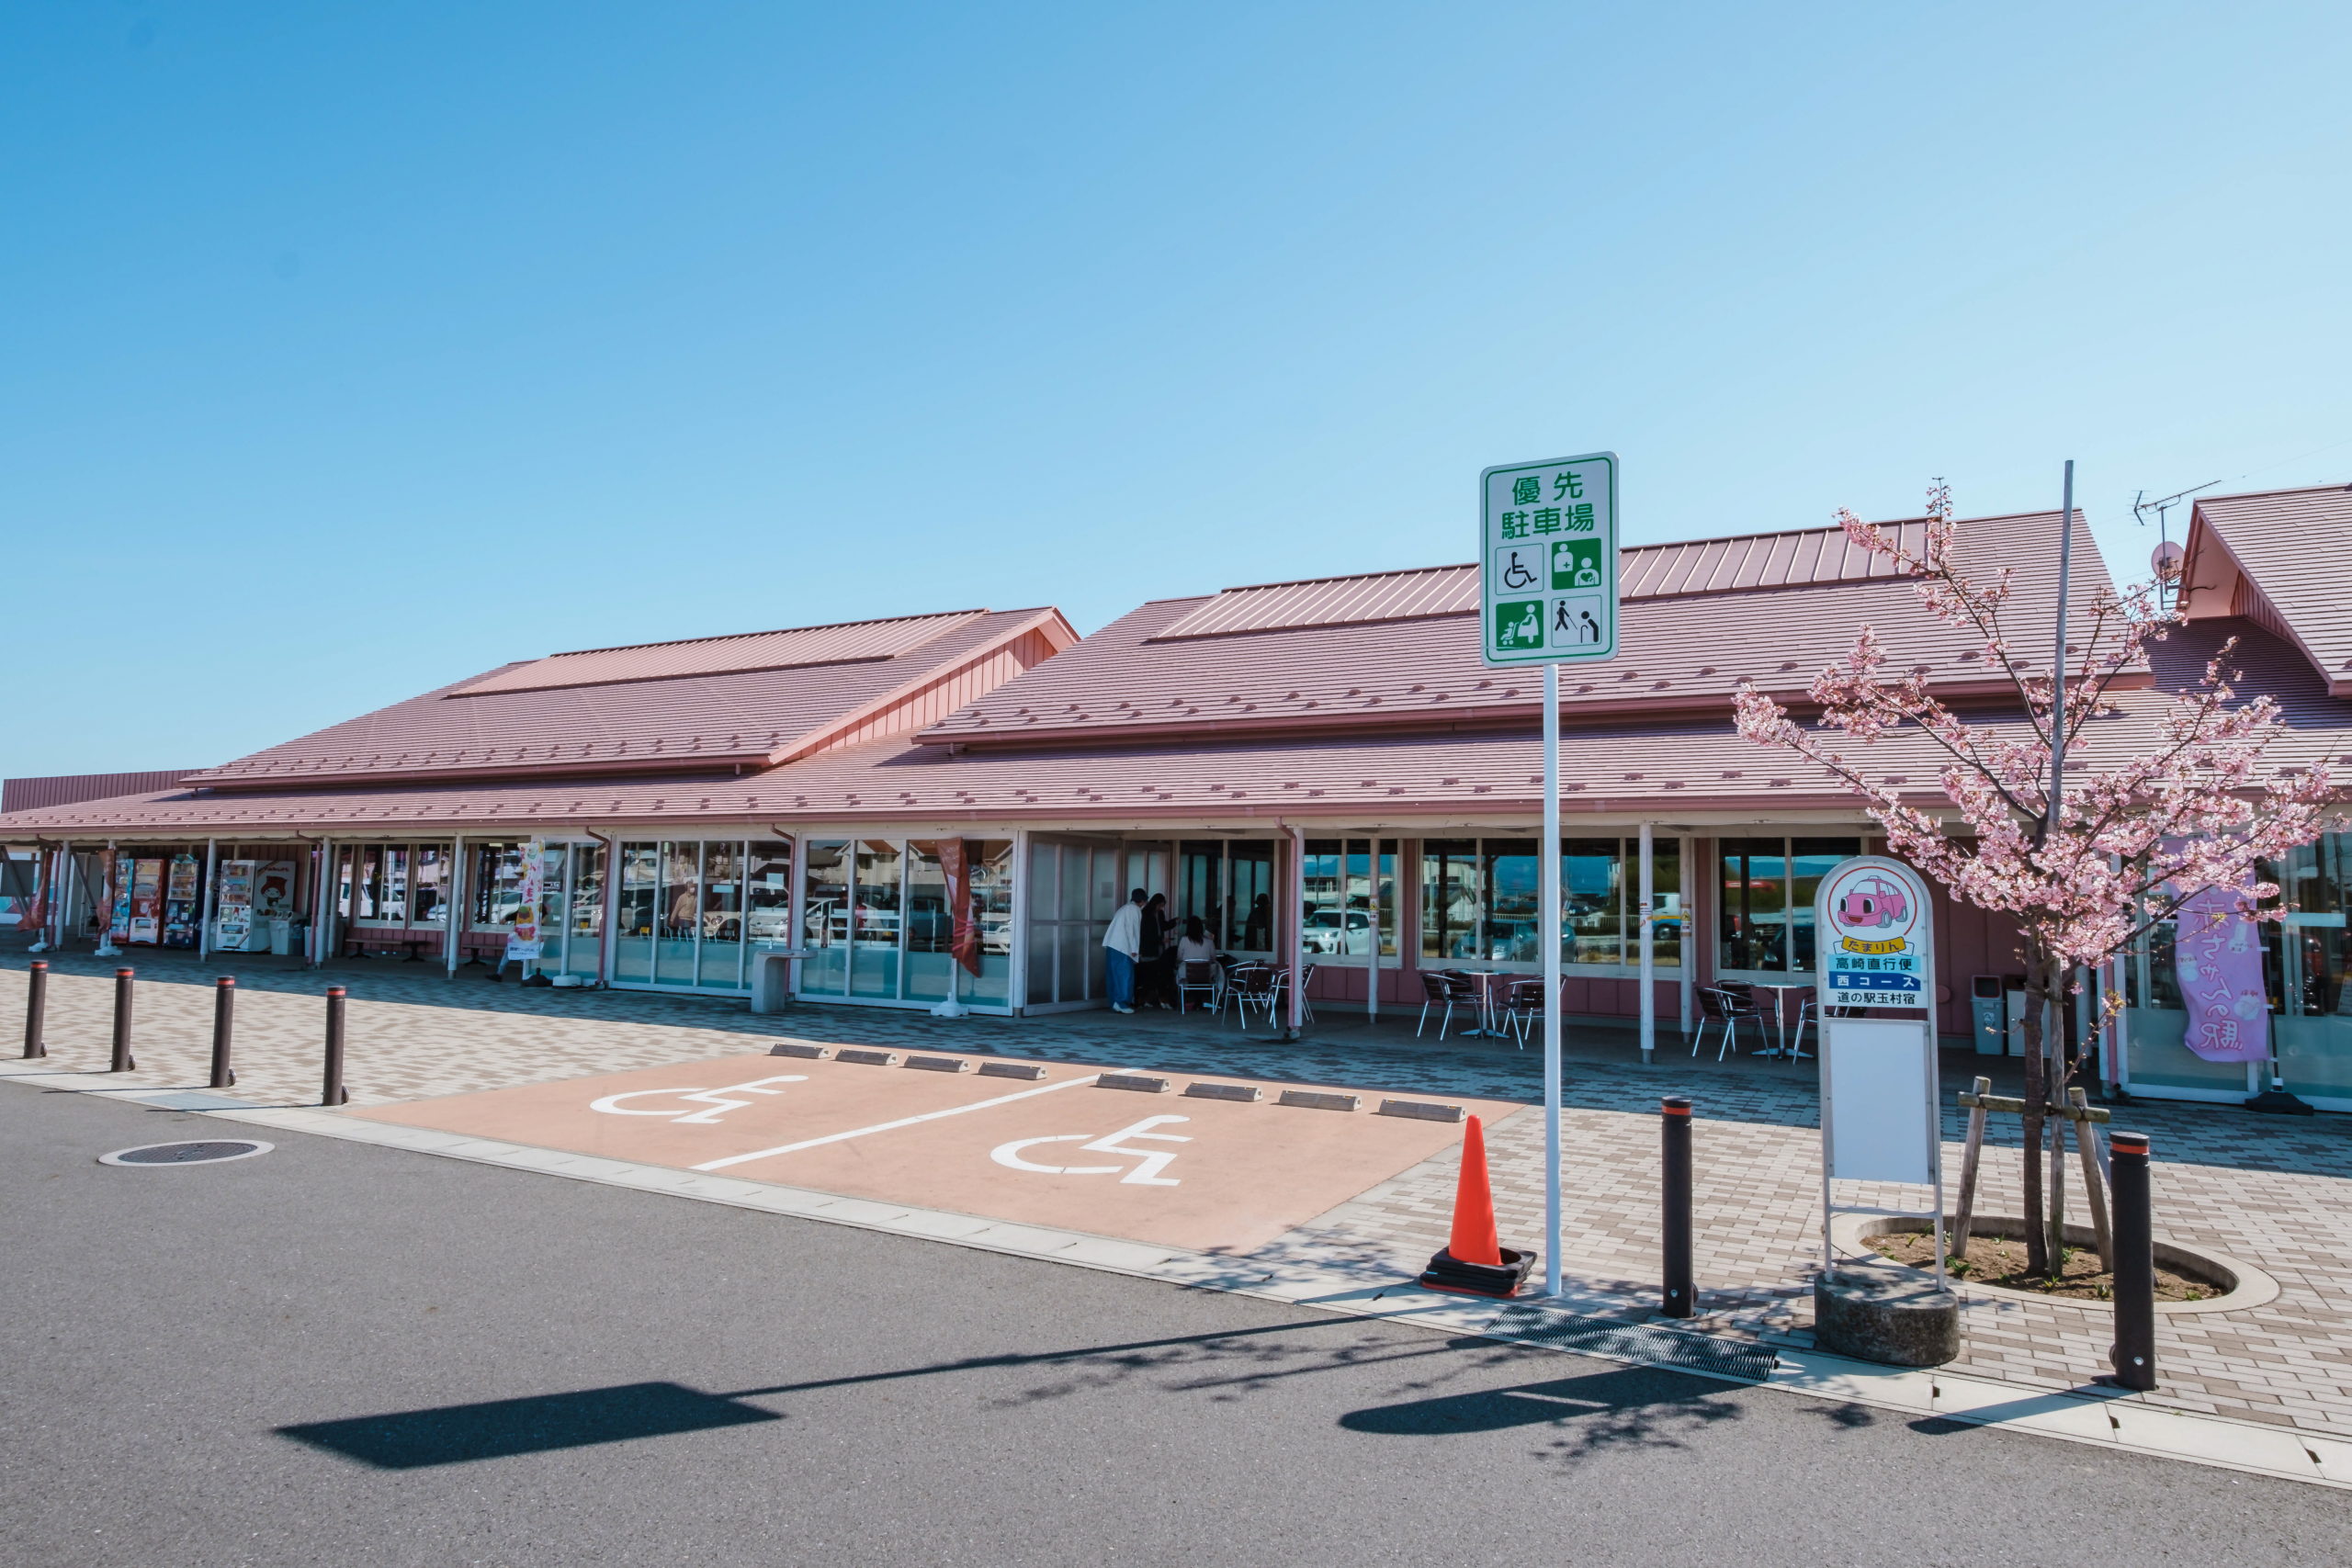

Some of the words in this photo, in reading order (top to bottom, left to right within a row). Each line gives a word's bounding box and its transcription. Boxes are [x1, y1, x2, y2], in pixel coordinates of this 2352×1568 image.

[1511, 470, 1584, 506] 優先
[1501, 502, 1595, 540] 駐車場
[1848, 940, 1900, 953] たまりん
[1836, 957, 1913, 971] 高崎直行便
[1837, 975, 1915, 987] 西コース
[1838, 991, 1916, 1005] 道の駅玉村宿
